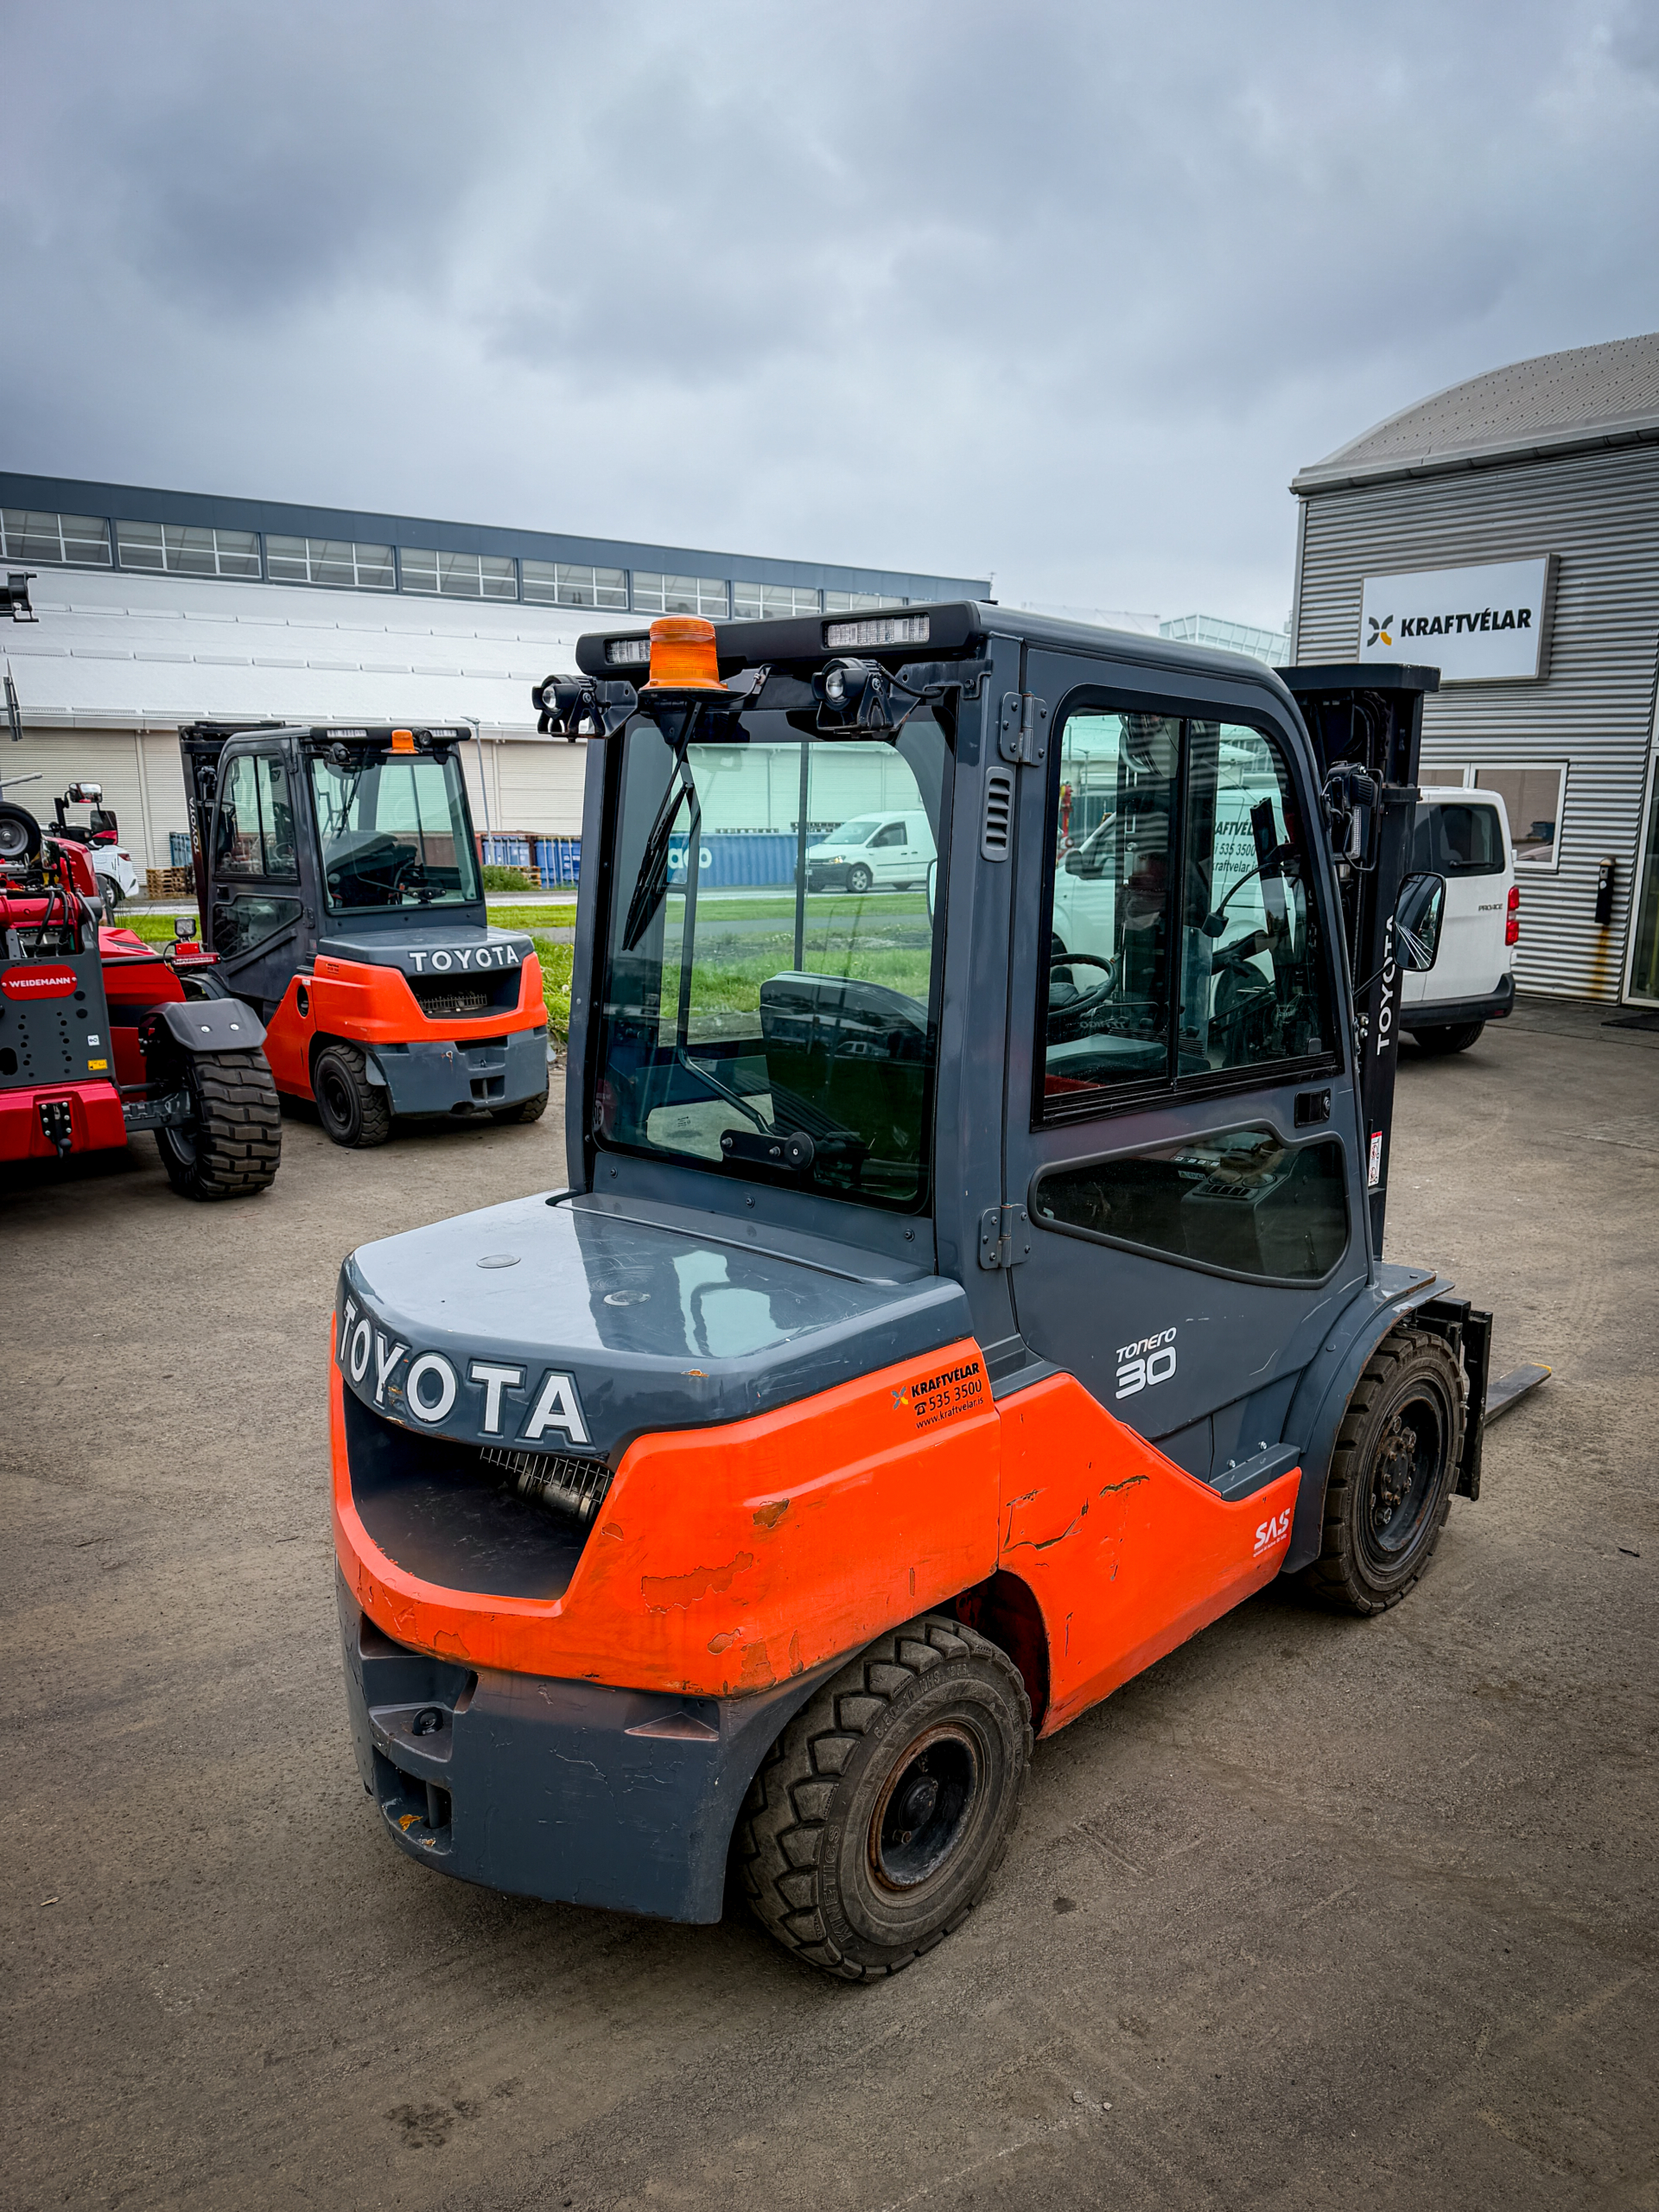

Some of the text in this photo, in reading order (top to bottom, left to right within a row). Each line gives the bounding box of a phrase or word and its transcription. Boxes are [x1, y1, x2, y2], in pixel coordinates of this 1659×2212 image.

[1401, 607, 1531, 637] KRAFTVÉLAR
[189, 797, 200, 855] TOYOTA
[1215, 819, 1254, 836] AFTVÉL
[1219, 843, 1235, 855] 535
[1236, 843, 1255, 856] 3500
[409, 944, 519, 972] TOYOTA
[9, 976, 71, 988] WEIDEMANN
[340, 1298, 588, 1443] TOYOTA
[911, 1363, 980, 1398] KRAFTVÉLAR
[1116, 1346, 1177, 1399] 30
[929, 1379, 982, 1411] 535 3500
[916, 1396, 984, 1429] www.kraftvelar.is
[1254, 1508, 1291, 1550] SAS
